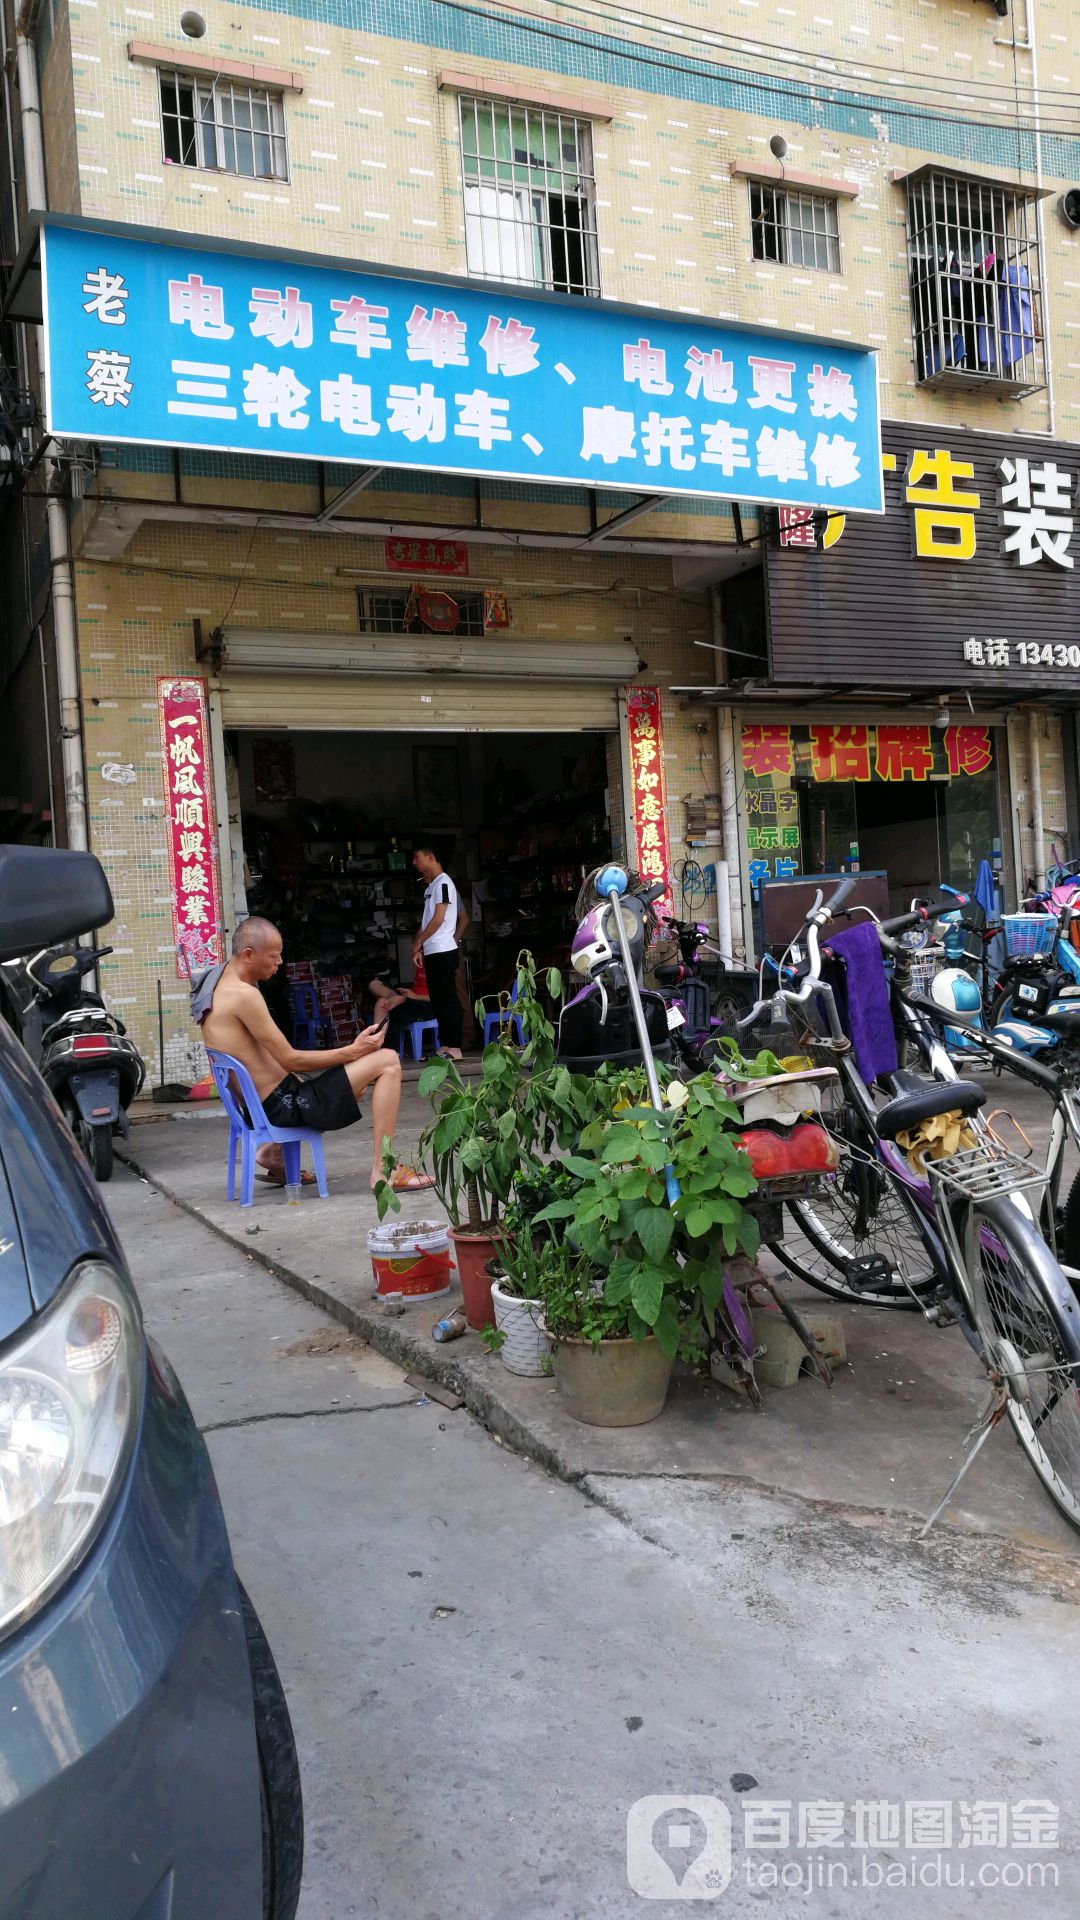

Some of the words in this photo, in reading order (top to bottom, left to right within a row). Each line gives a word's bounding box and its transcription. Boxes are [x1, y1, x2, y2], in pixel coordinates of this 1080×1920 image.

[82, 267, 133, 408] 老蔡
[963, 637, 1010, 667] 电话
[1016, 642, 1080, 668] 13430
